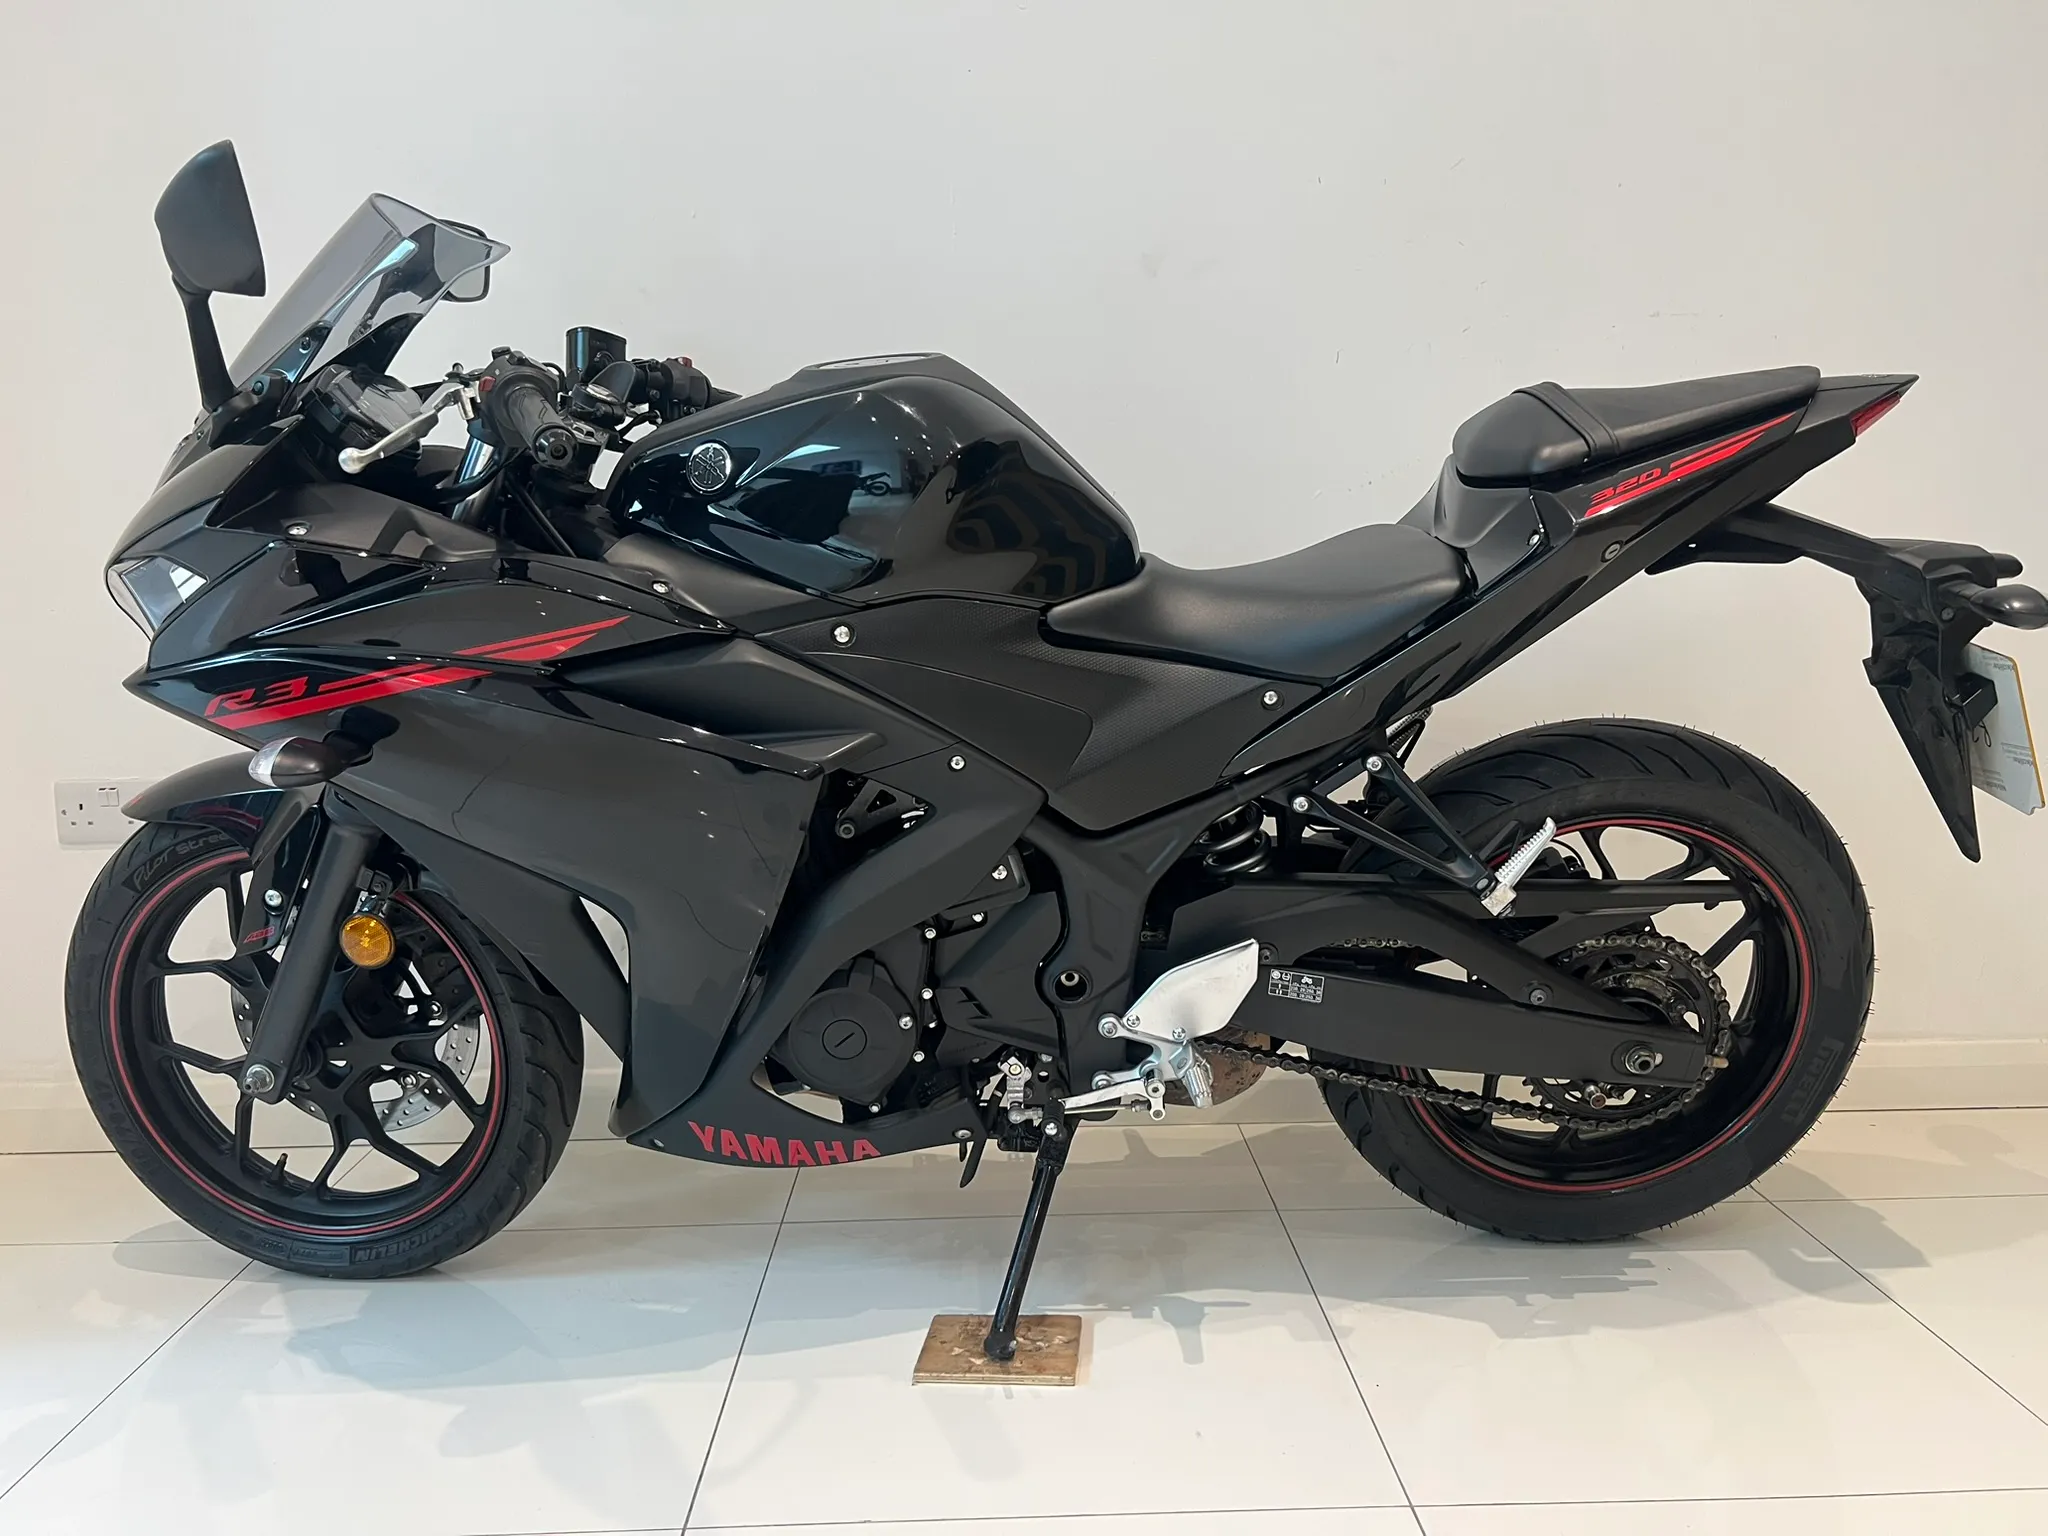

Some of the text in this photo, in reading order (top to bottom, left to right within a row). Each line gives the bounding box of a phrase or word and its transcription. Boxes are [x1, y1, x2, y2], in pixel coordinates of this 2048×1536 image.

[1591, 468, 1662, 504] 320
[204, 676, 308, 716] R3
[687, 1120, 881, 1166] YAMAHA
[353, 1223, 444, 1263] MICHELIN
